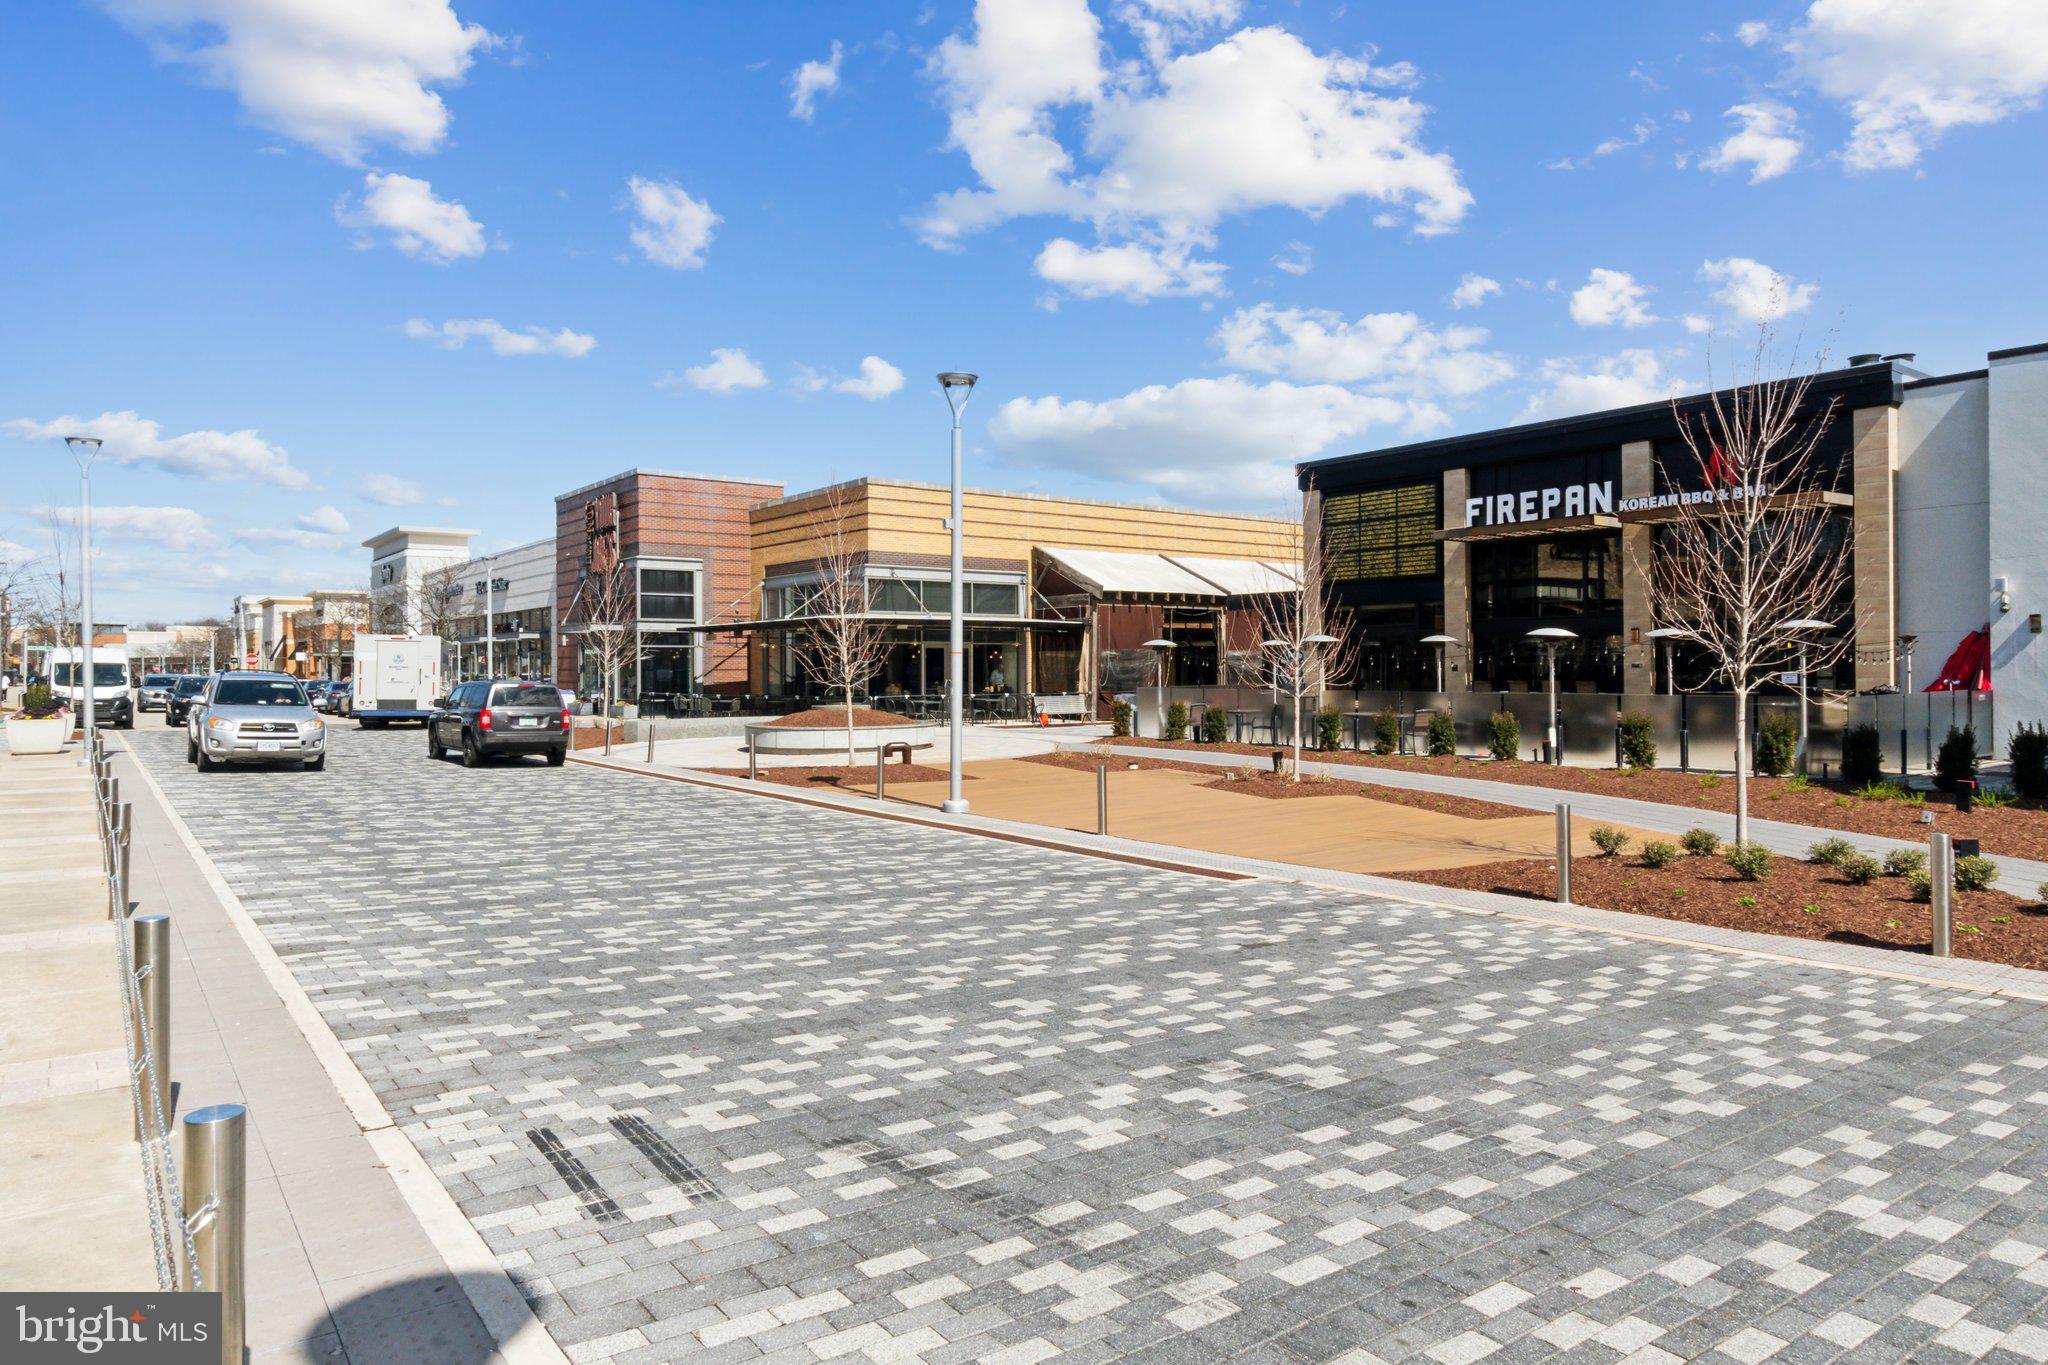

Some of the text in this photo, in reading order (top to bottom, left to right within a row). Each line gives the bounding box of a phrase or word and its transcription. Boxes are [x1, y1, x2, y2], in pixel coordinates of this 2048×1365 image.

[1465, 481, 1612, 528] FIREPAN
[1618, 484, 1767, 511] KOREAN BBQ & BAR
